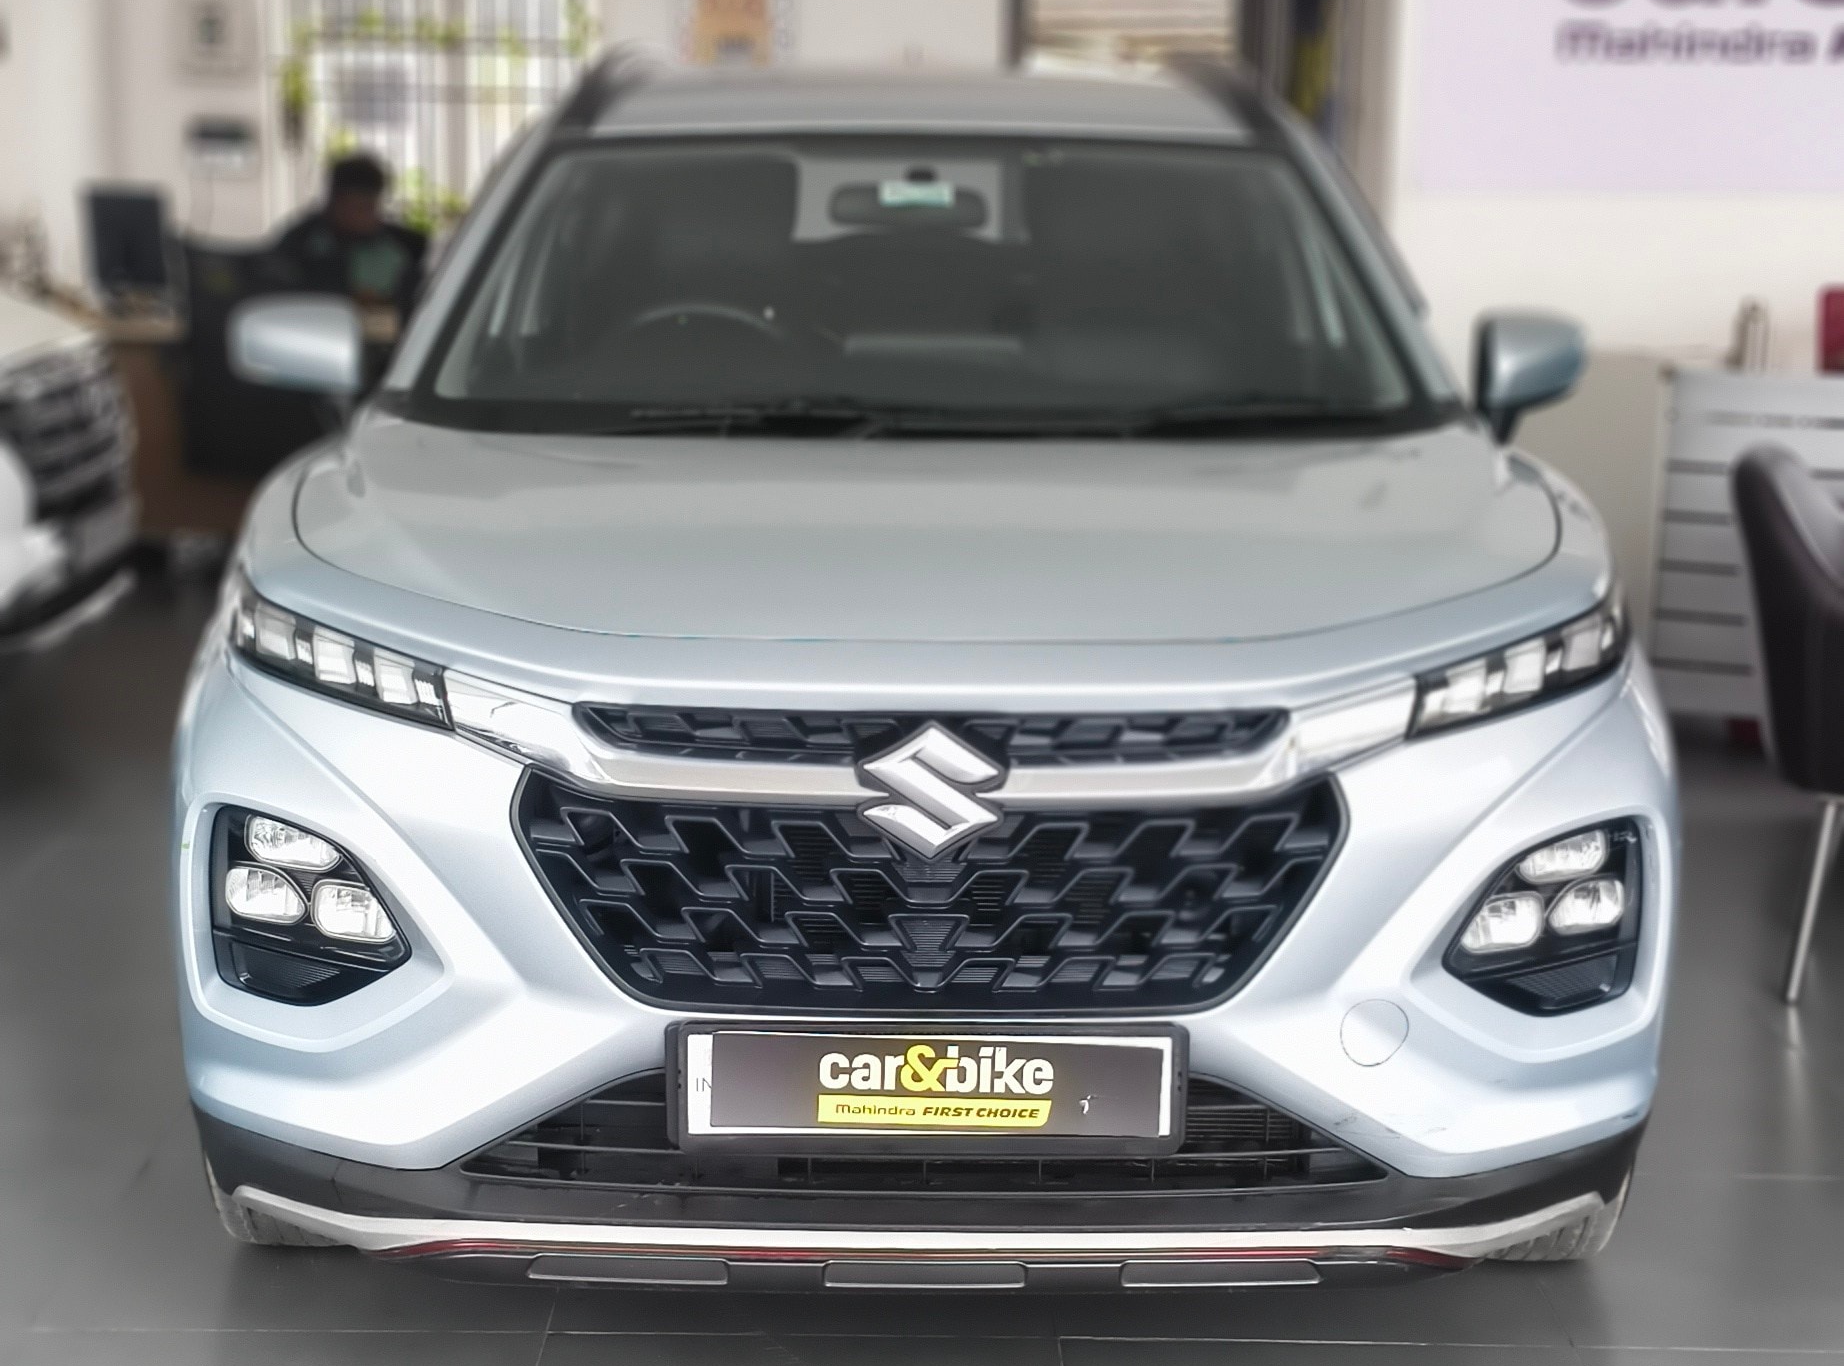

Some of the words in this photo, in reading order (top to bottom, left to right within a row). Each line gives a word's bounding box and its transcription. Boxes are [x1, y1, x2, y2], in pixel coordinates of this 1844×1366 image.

[818, 1045, 1054, 1094] car&bike
[835, 1104, 916, 1116] Mahindra
[922, 1106, 975, 1117] FIRST
[976, 1108, 1040, 1119] CHOICE
